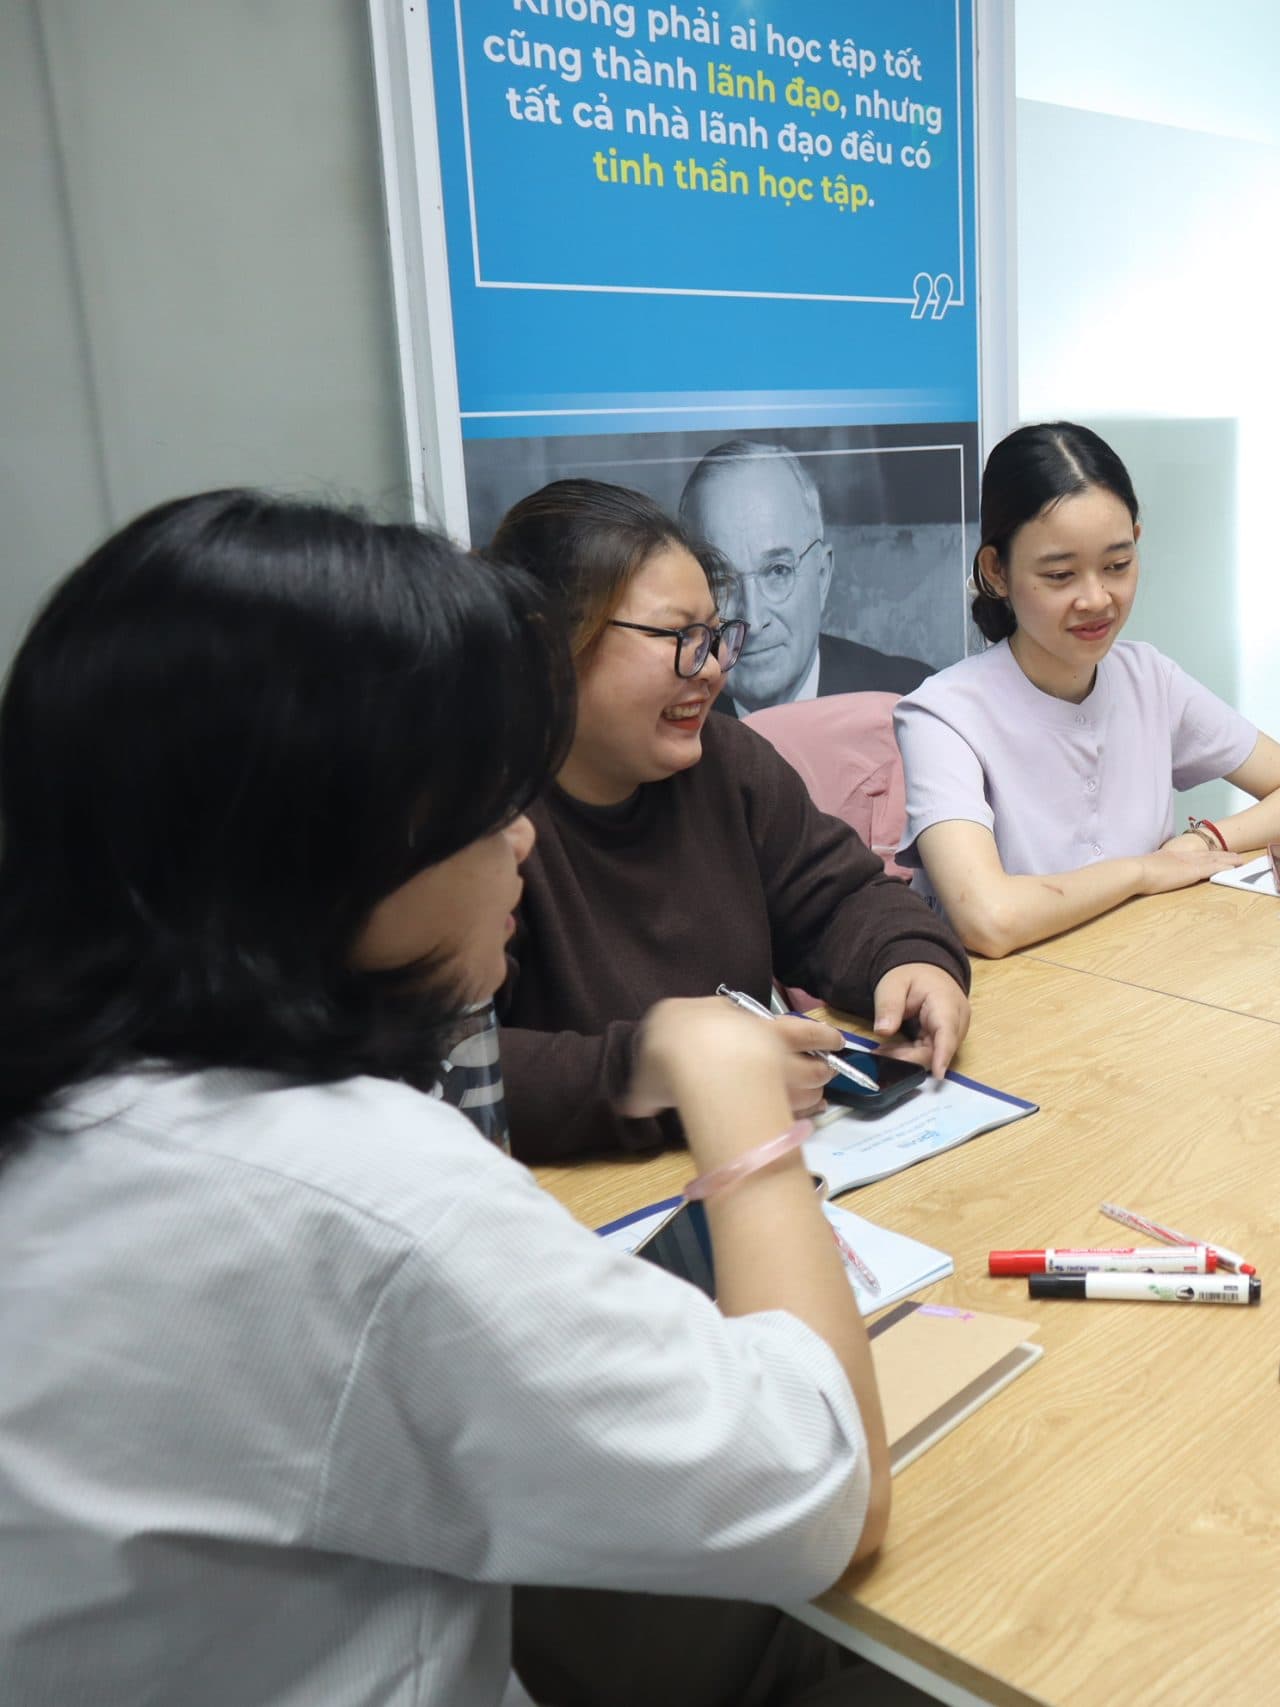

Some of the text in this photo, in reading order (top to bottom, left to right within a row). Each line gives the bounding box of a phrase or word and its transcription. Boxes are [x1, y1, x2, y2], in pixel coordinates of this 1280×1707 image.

[484, 30, 941, 135] cũng thành lãnh đạo, nhưng
[648, 5, 719, 45] phải
[731, 19, 756, 51] ai
[767, 24, 821, 62] học
[829, 39, 876, 78] tập
[884, 48, 922, 81] tốt
[506, 85, 931, 168] tất cả nhà lãnh đạo đều có
[593, 148, 874, 212] tinh thần học tập.
